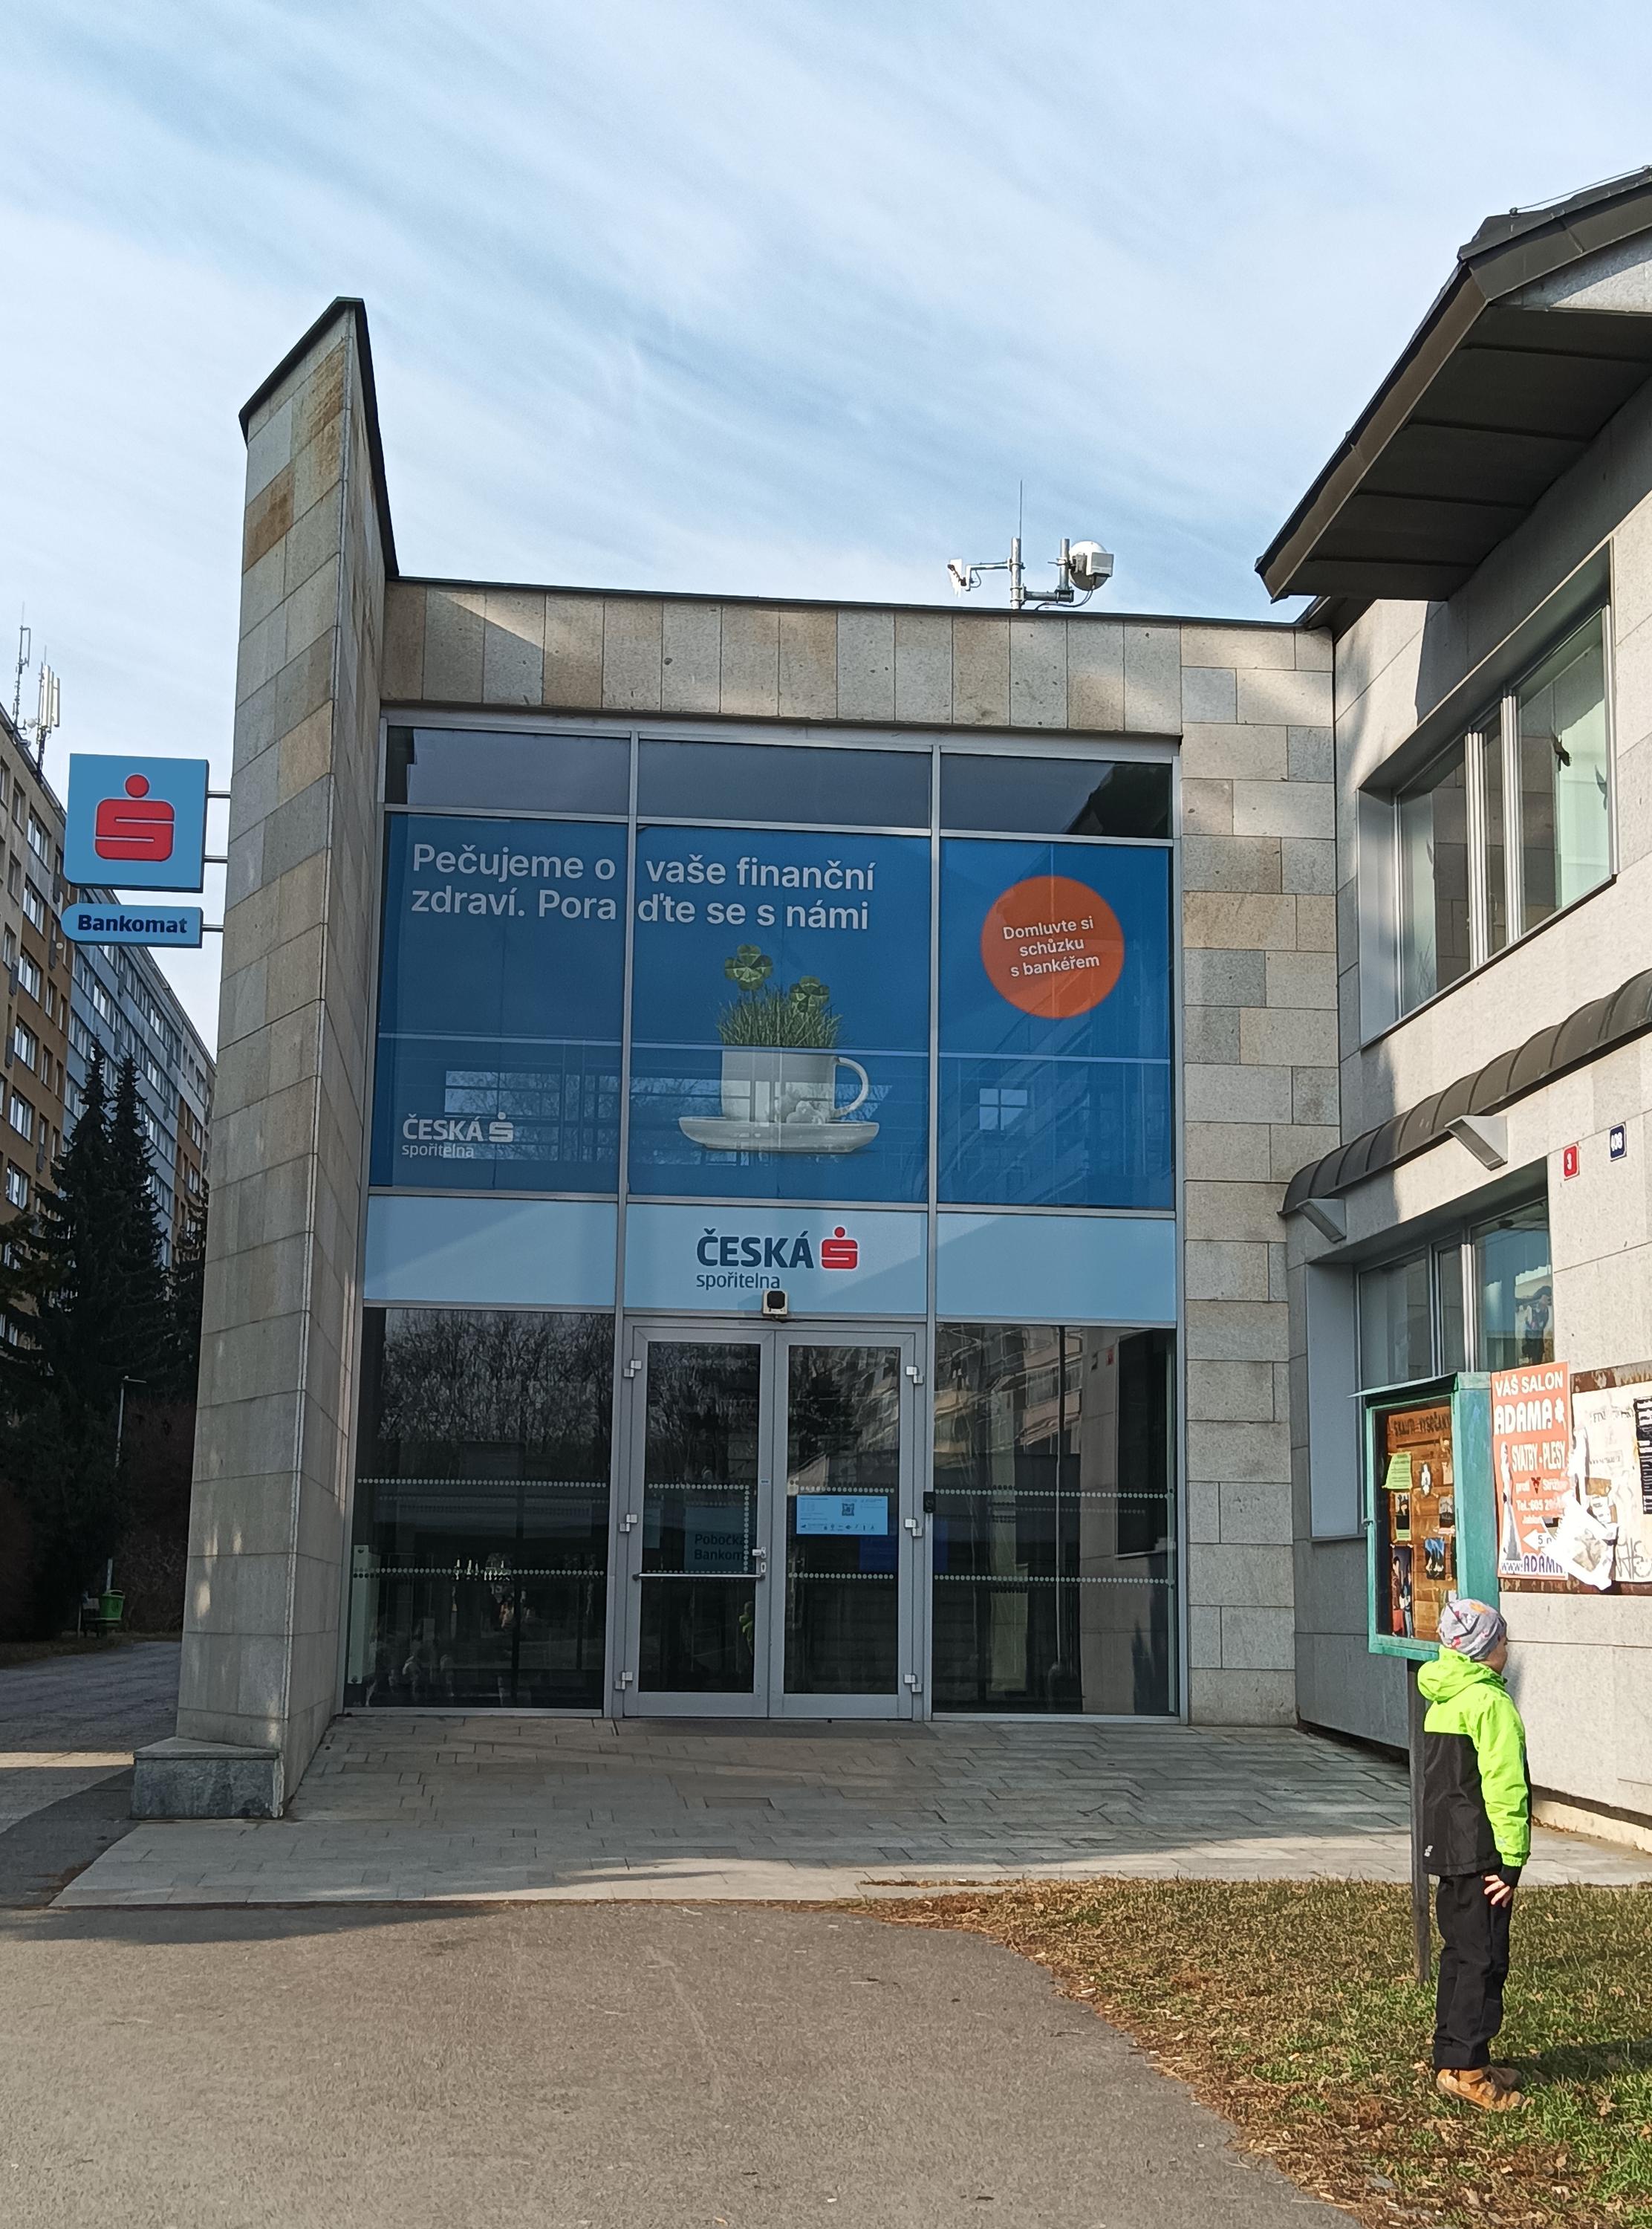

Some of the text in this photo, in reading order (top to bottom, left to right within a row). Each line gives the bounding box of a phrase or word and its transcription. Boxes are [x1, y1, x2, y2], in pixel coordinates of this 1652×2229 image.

[413, 843, 877, 891] Pečujeme o vaše finanční
[411, 885, 525, 917] zdraví.
[707, 903, 746, 926] se
[757, 904, 775, 927] s
[786, 900, 868, 930] námi
[77, 914, 187, 934] Bankomat
[1003, 915, 1094, 940] Domluvte si
[1019, 938, 1084, 957] schůzku
[1011, 955, 1100, 977] s bankéřem
[403, 1113, 484, 1142] ČESKÁ
[402, 1142, 475, 1159] spořitelna
[697, 1227, 814, 1269] ČESKÁ
[696, 1271, 780, 1291] spořitelna
[1495, 1370, 1564, 1398] VÁŠ SALON
[1494, 1398, 1552, 1435] ADAMA
[1512, 1443, 1538, 1473] SVATBY
[1542, 1440, 1565, 1470] PLESY
[1538, 1534, 1544, 1545] 5
